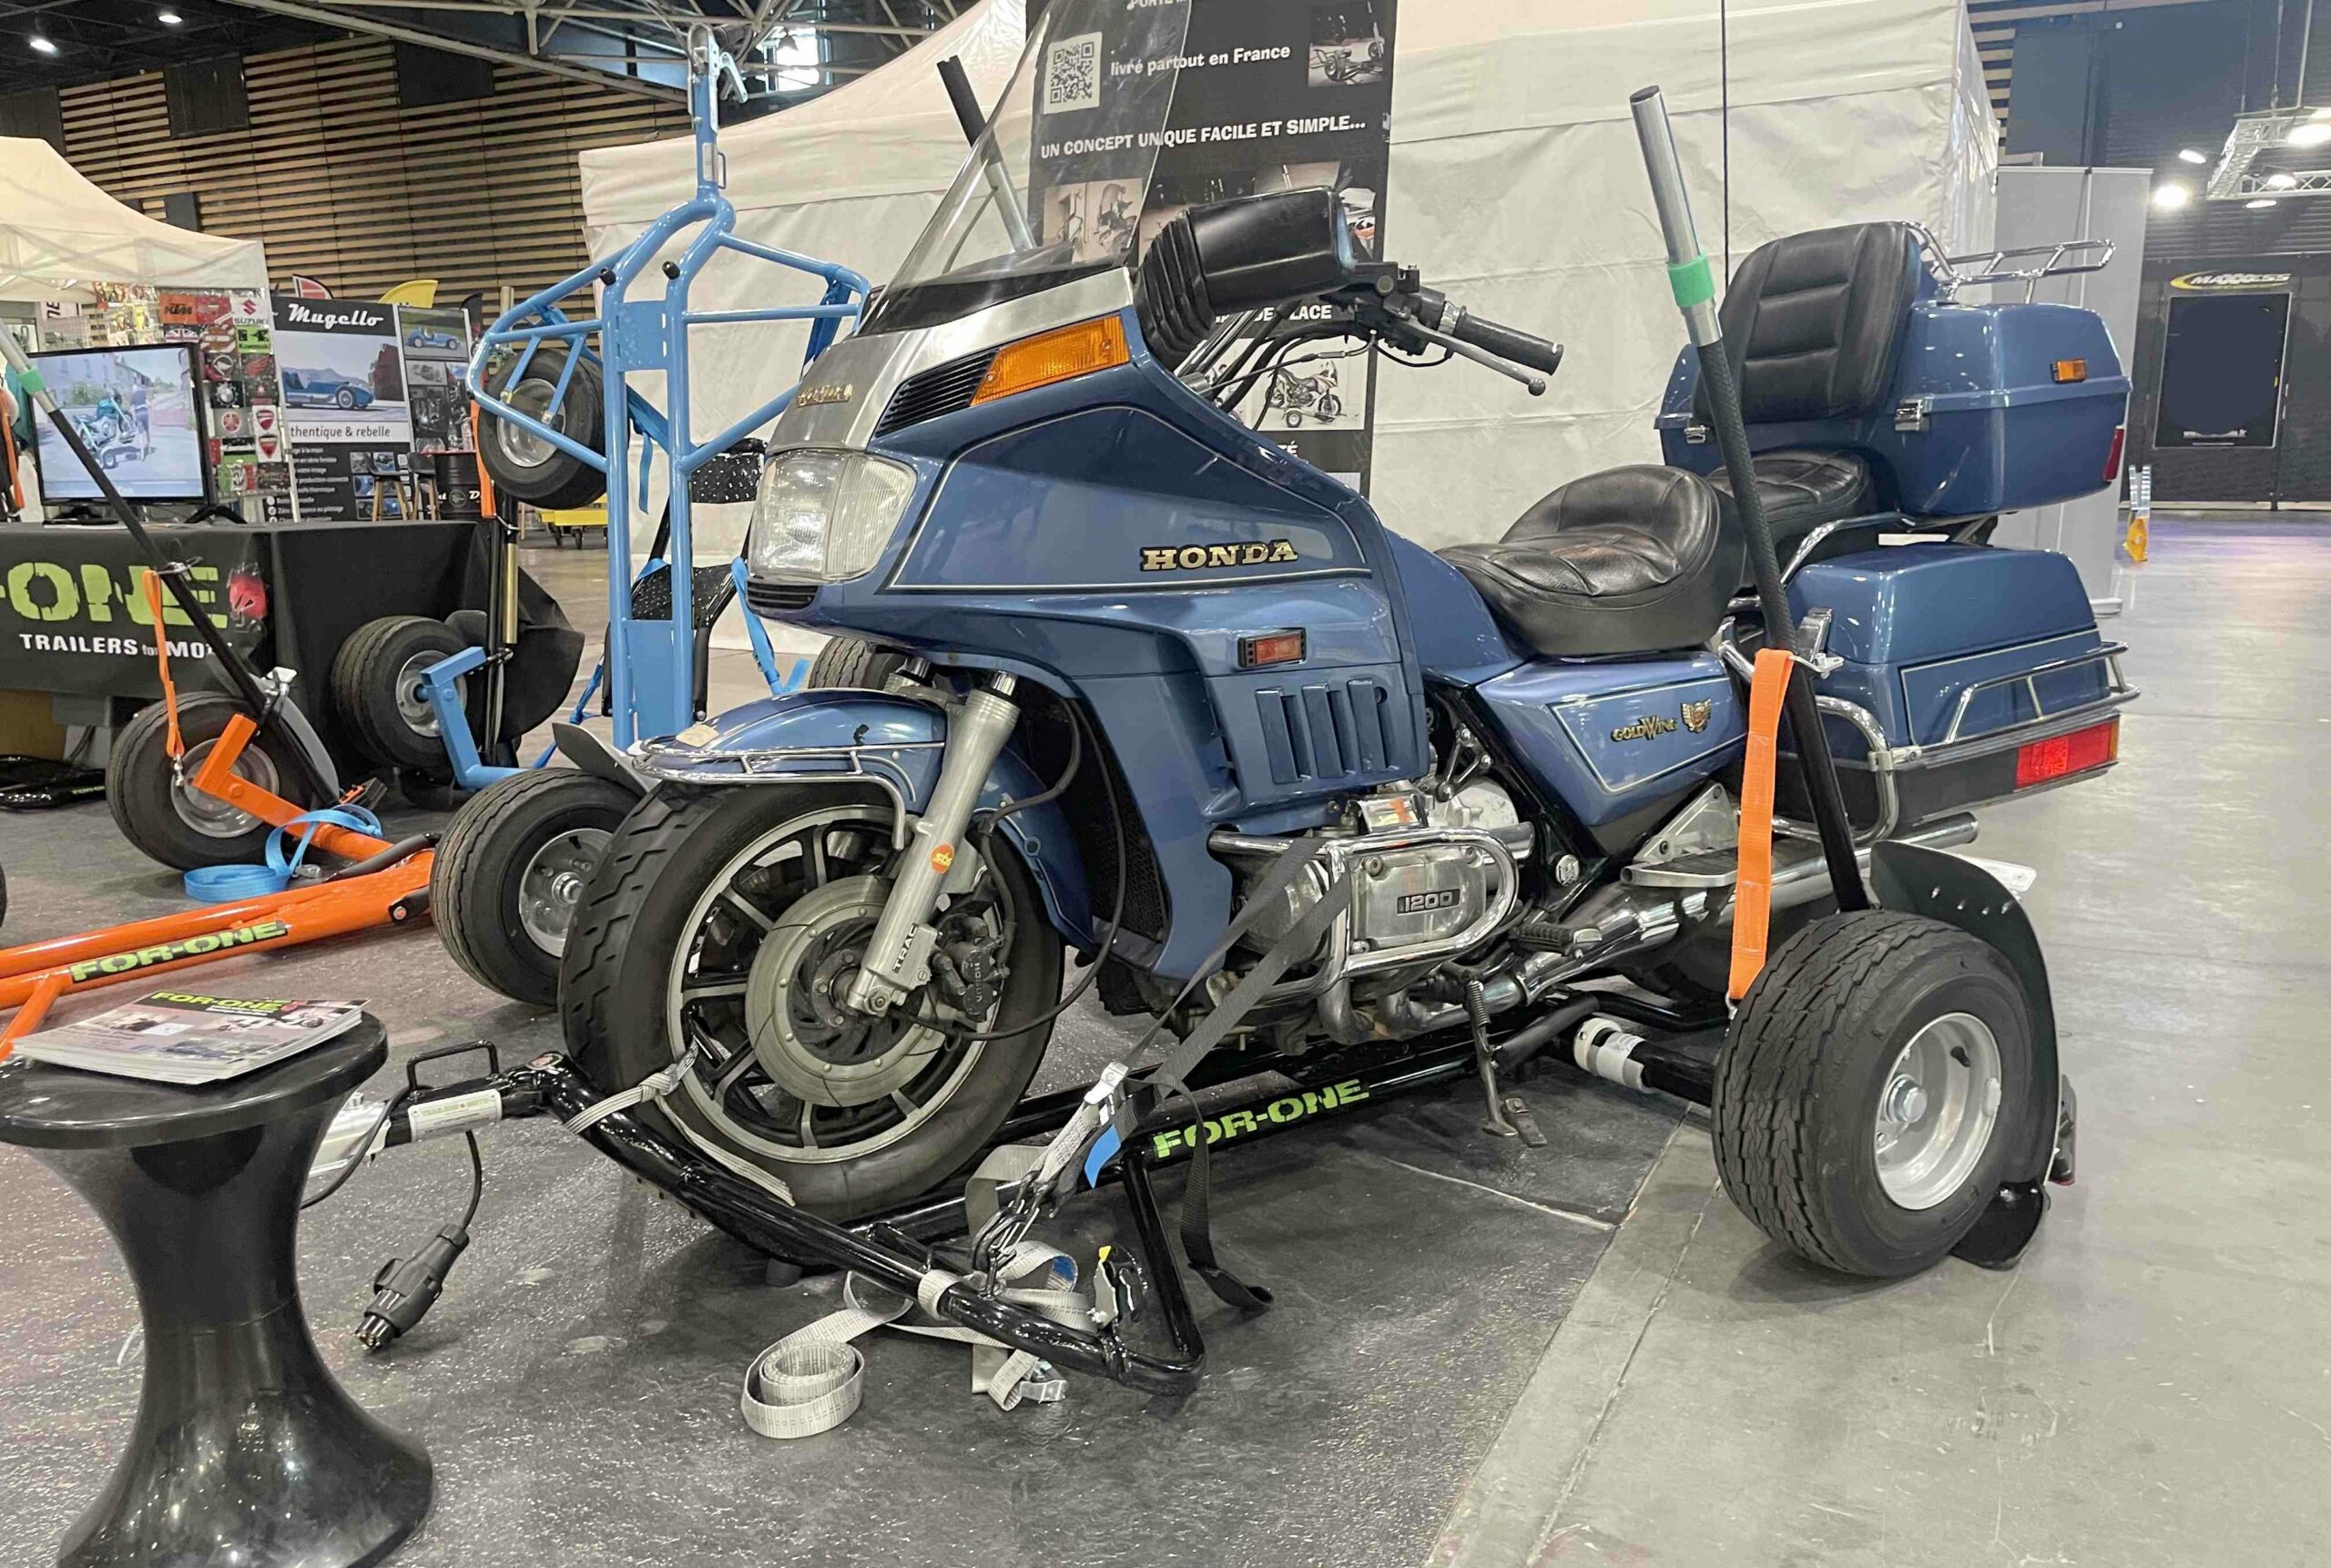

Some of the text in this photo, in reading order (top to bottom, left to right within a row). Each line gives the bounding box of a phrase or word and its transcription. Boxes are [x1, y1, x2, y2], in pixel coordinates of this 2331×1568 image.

[1110, 46, 1290, 76] livré partout en France
[1041, 115, 1366, 158] UN CONCEPT UNIQUE FACILE ET SIMPLE...
[288, 303, 384, 330] Mugello
[1288, 305, 1332, 321] LACE
[345, 426, 353, 437] &
[356, 425, 391, 437] rebelle
[1142, 539, 1298, 572] HONDA
[0, 562, 228, 629] ONE
[19, 633, 137, 656] TRAILERS
[1403, 891, 1454, 912] 1200
[69, 921, 287, 983] FOR-ONE
[892, 923, 919, 972] TRAC
[151, 992, 292, 1012] FOR-ONE
[1153, 1078, 1370, 1159] FOR-ONE
